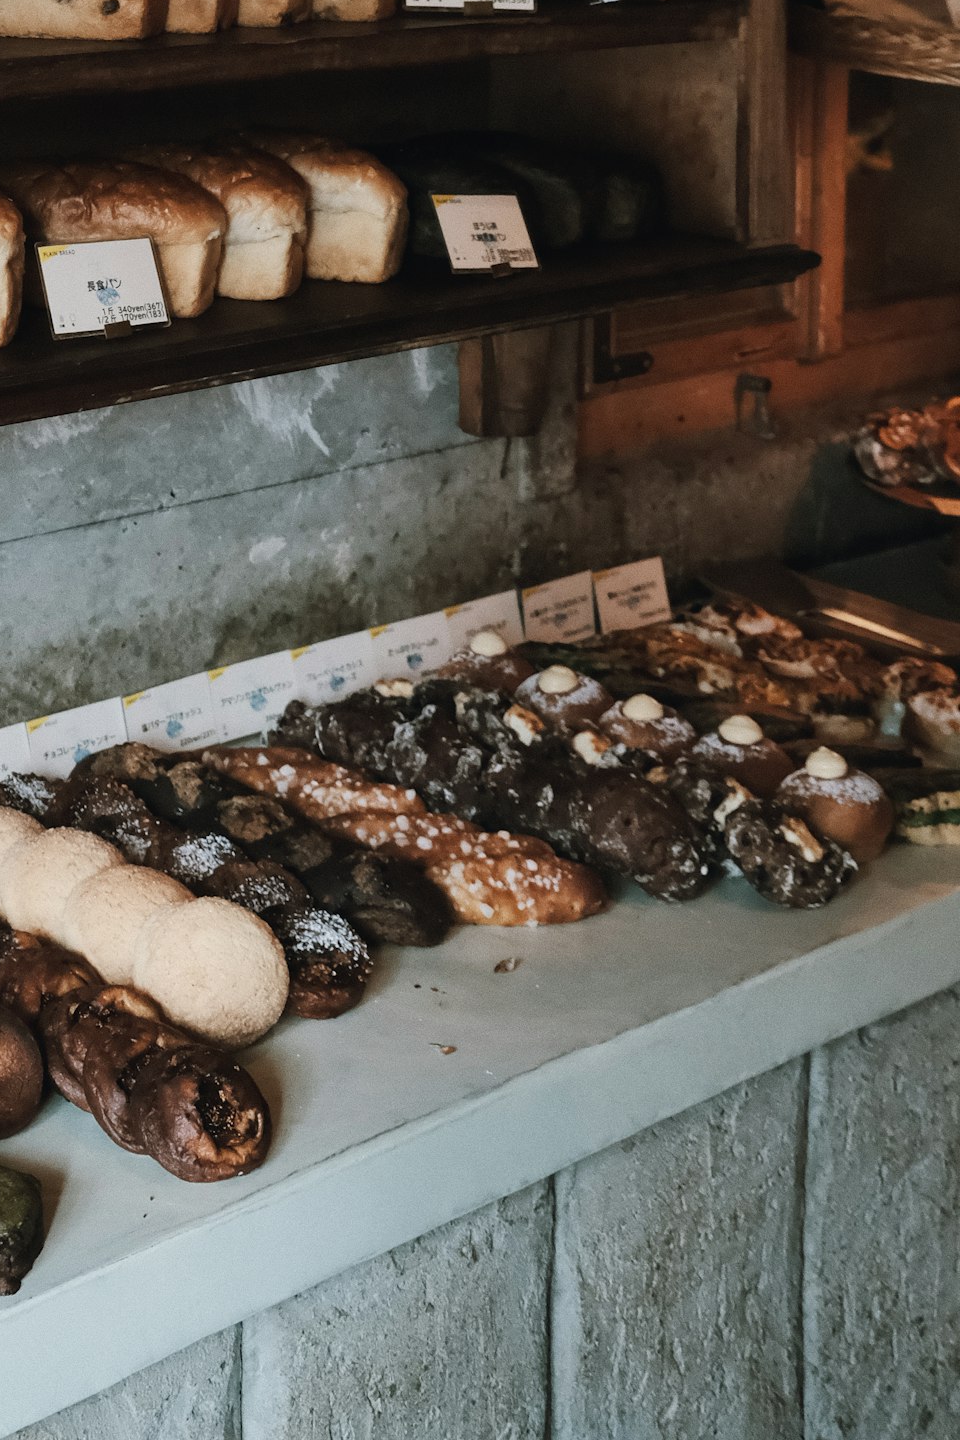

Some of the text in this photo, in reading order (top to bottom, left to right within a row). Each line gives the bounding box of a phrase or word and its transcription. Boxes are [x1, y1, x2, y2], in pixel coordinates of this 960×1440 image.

[87, 278, 122, 292] 長食パン
[117, 301, 163, 314] 340yen(367)
[120, 309, 165, 321] 170yen(183)
